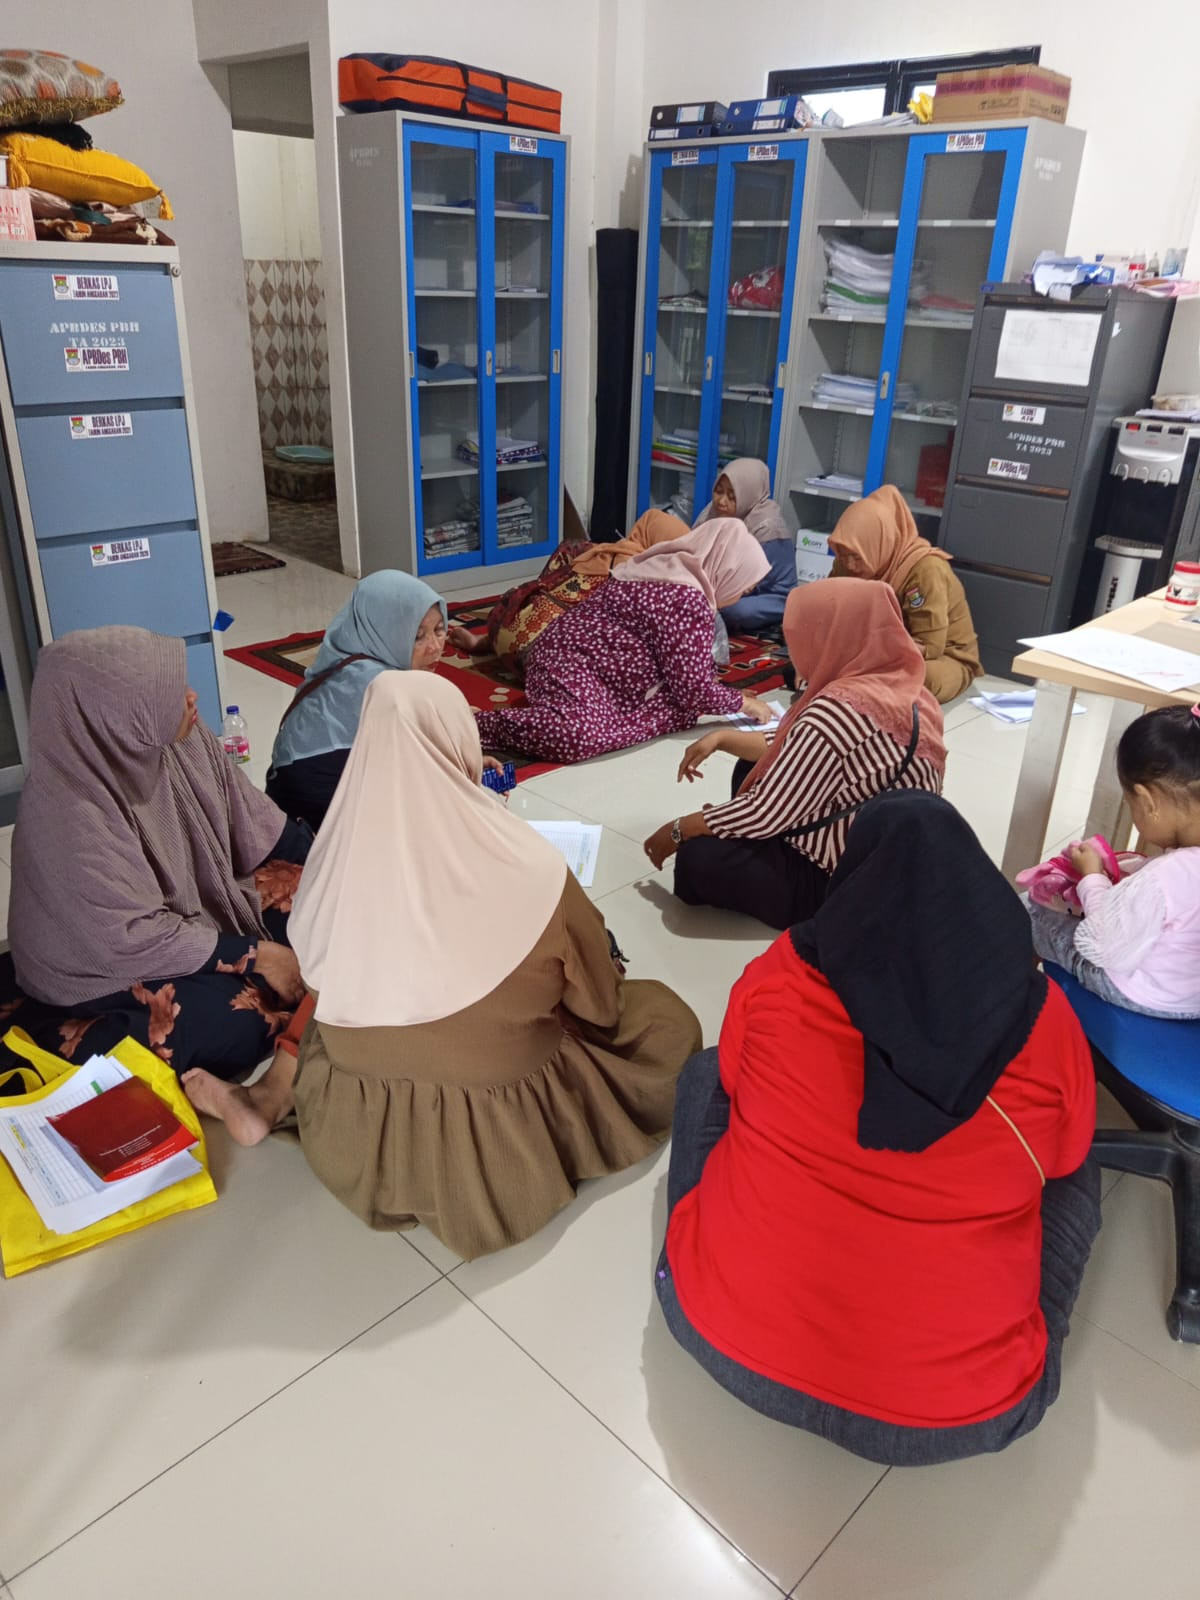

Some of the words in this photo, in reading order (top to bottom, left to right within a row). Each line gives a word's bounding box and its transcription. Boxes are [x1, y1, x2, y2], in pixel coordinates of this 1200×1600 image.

[49, 322, 106, 333] APBDES
[91, 336, 126, 347] 2023
[82, 349, 111, 364] APBDes
[112, 349, 127, 363] PBH
